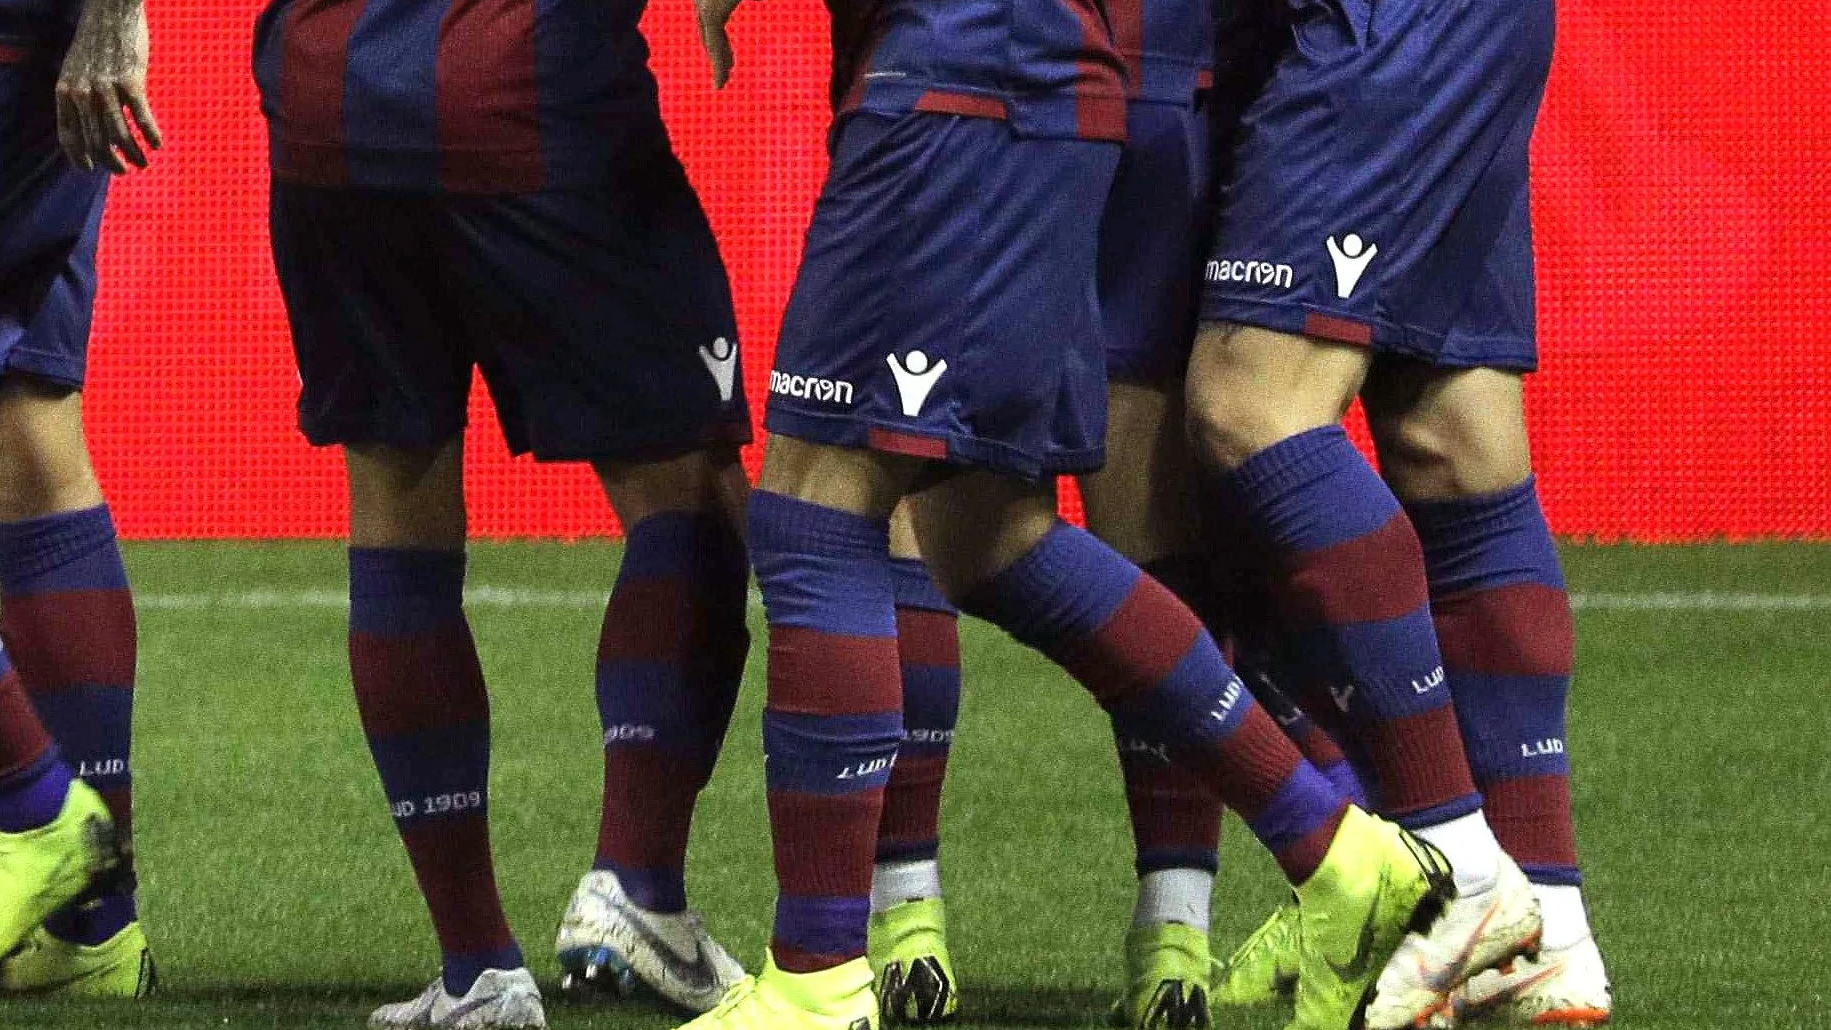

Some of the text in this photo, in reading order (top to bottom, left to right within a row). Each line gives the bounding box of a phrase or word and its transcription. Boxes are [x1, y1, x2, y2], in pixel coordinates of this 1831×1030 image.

[1203, 259, 1293, 289] macron
[770, 369, 853, 405] macron
[1411, 665, 1444, 694] LUD
[1521, 736, 1564, 758] LUD
[79, 759, 125, 777] LUD
[835, 756, 888, 780] LUD
[423, 791, 481, 815] 1909
